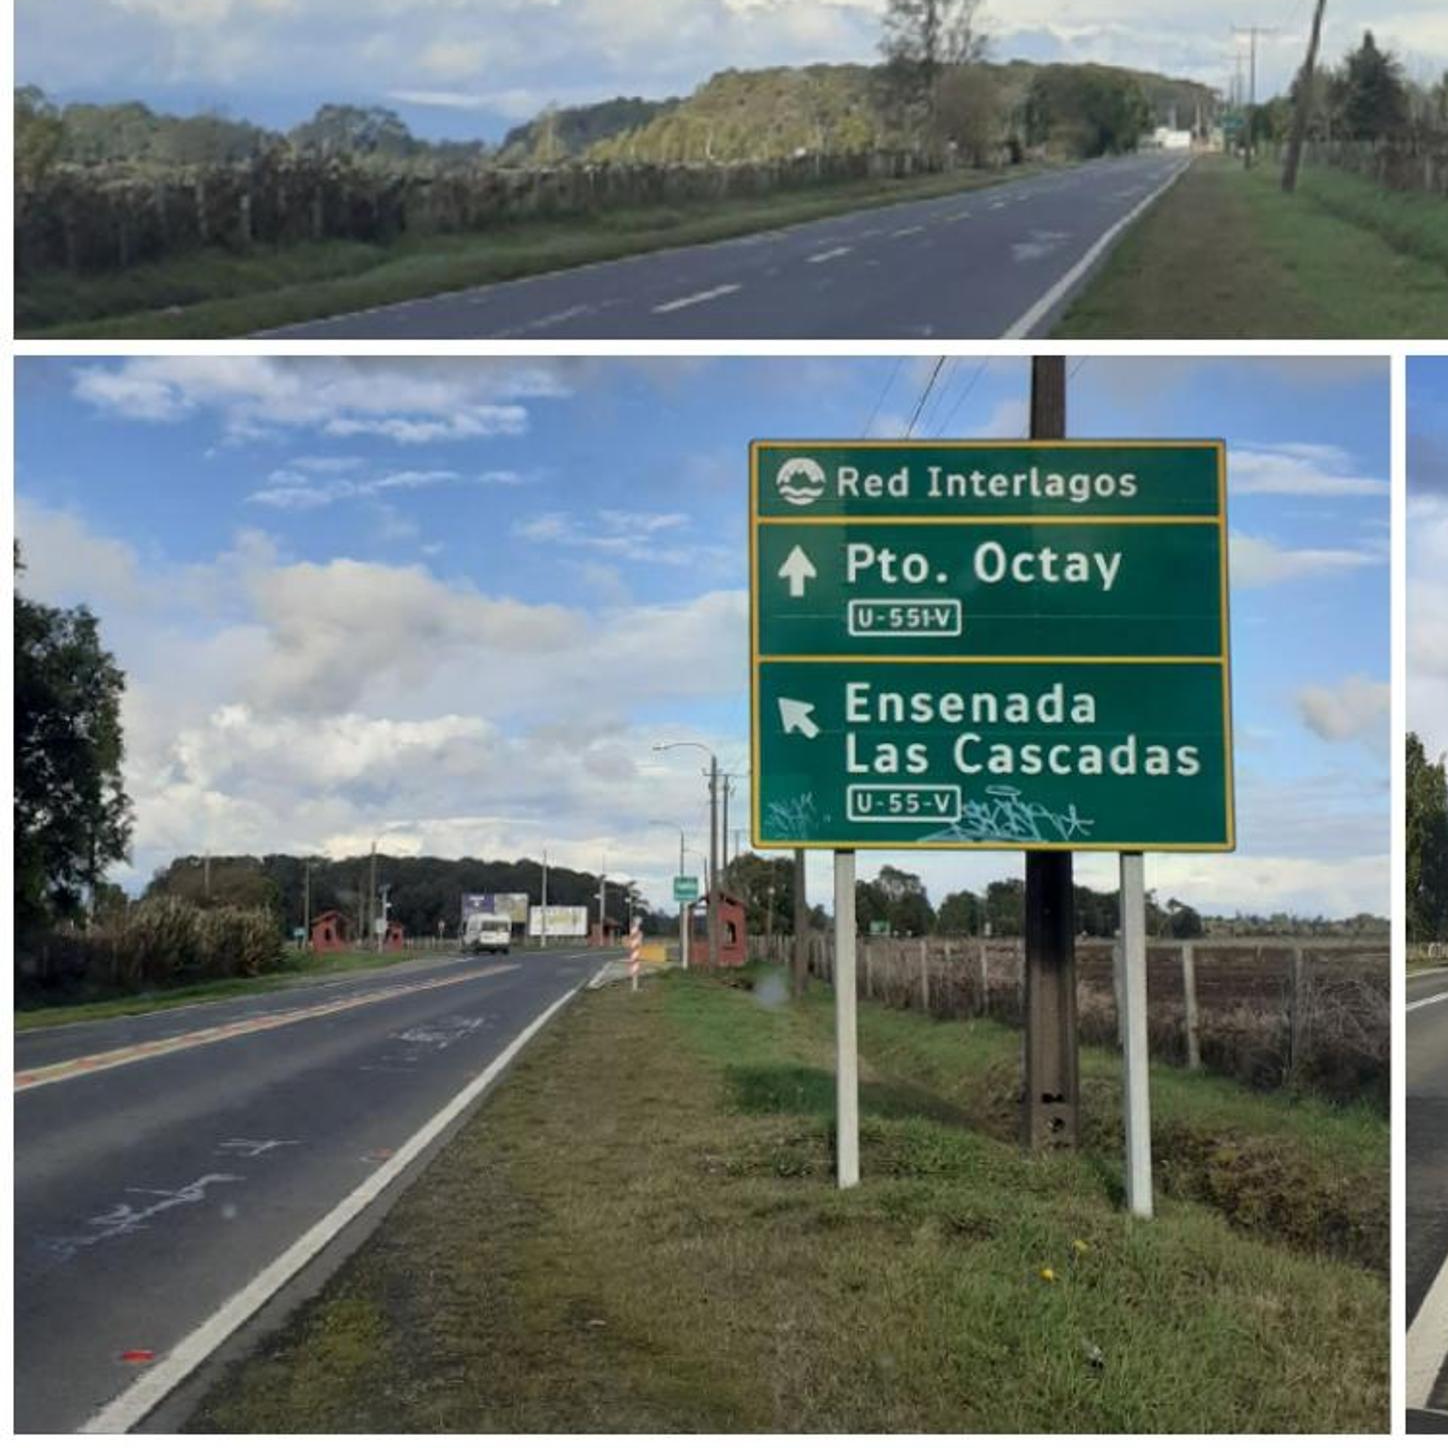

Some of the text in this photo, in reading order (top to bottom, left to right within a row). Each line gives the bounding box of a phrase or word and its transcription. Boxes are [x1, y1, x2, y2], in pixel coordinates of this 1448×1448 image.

[837, 466, 1137, 504] Red Interlagos
[846, 541, 1122, 591] Pto. Octay
[857, 607, 950, 628] U-551-V
[846, 682, 1096, 724] Ensenada
[846, 732, 1200, 776] Las Cascadas
[856, 792, 951, 814] U-55-V
